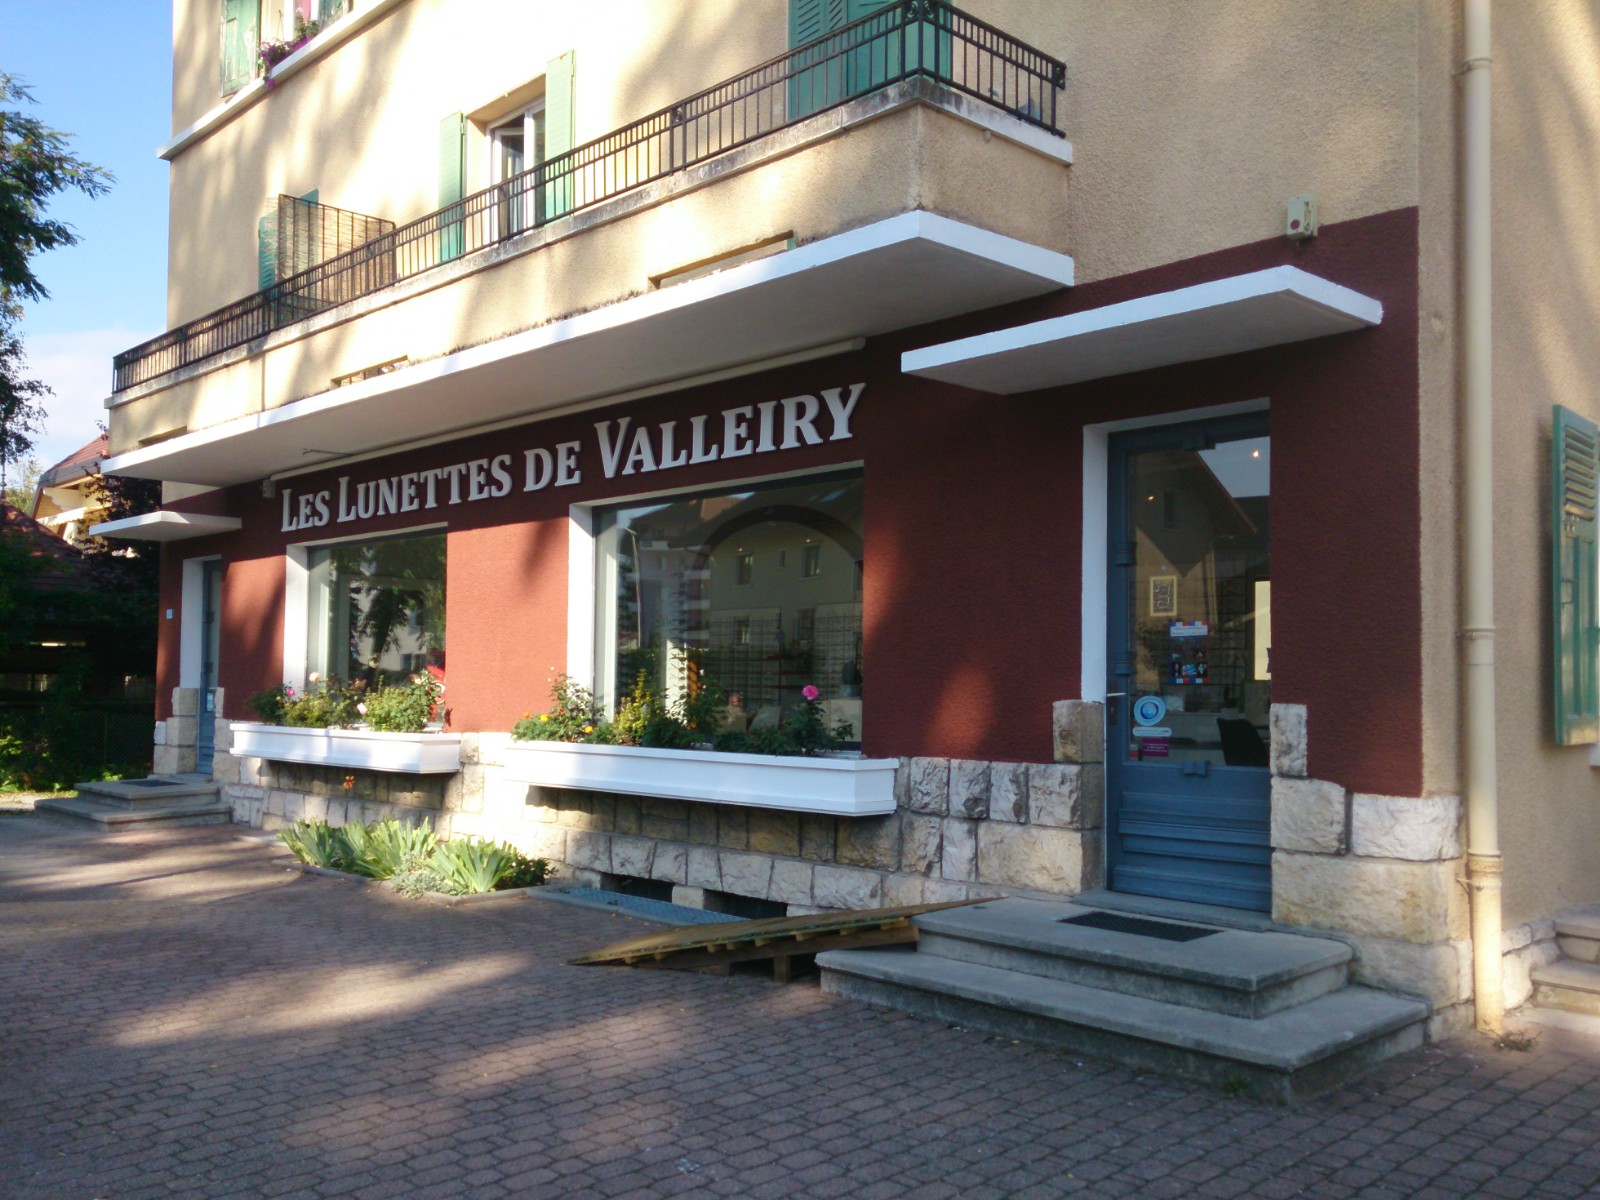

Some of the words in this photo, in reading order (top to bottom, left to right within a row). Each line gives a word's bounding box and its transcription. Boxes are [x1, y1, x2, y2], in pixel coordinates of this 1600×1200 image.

[281, 489, 330, 532] LES
[338, 454, 512, 523] LUNETTES
[523, 441, 581, 493] DE
[594, 383, 866, 479] VALLEIRY
